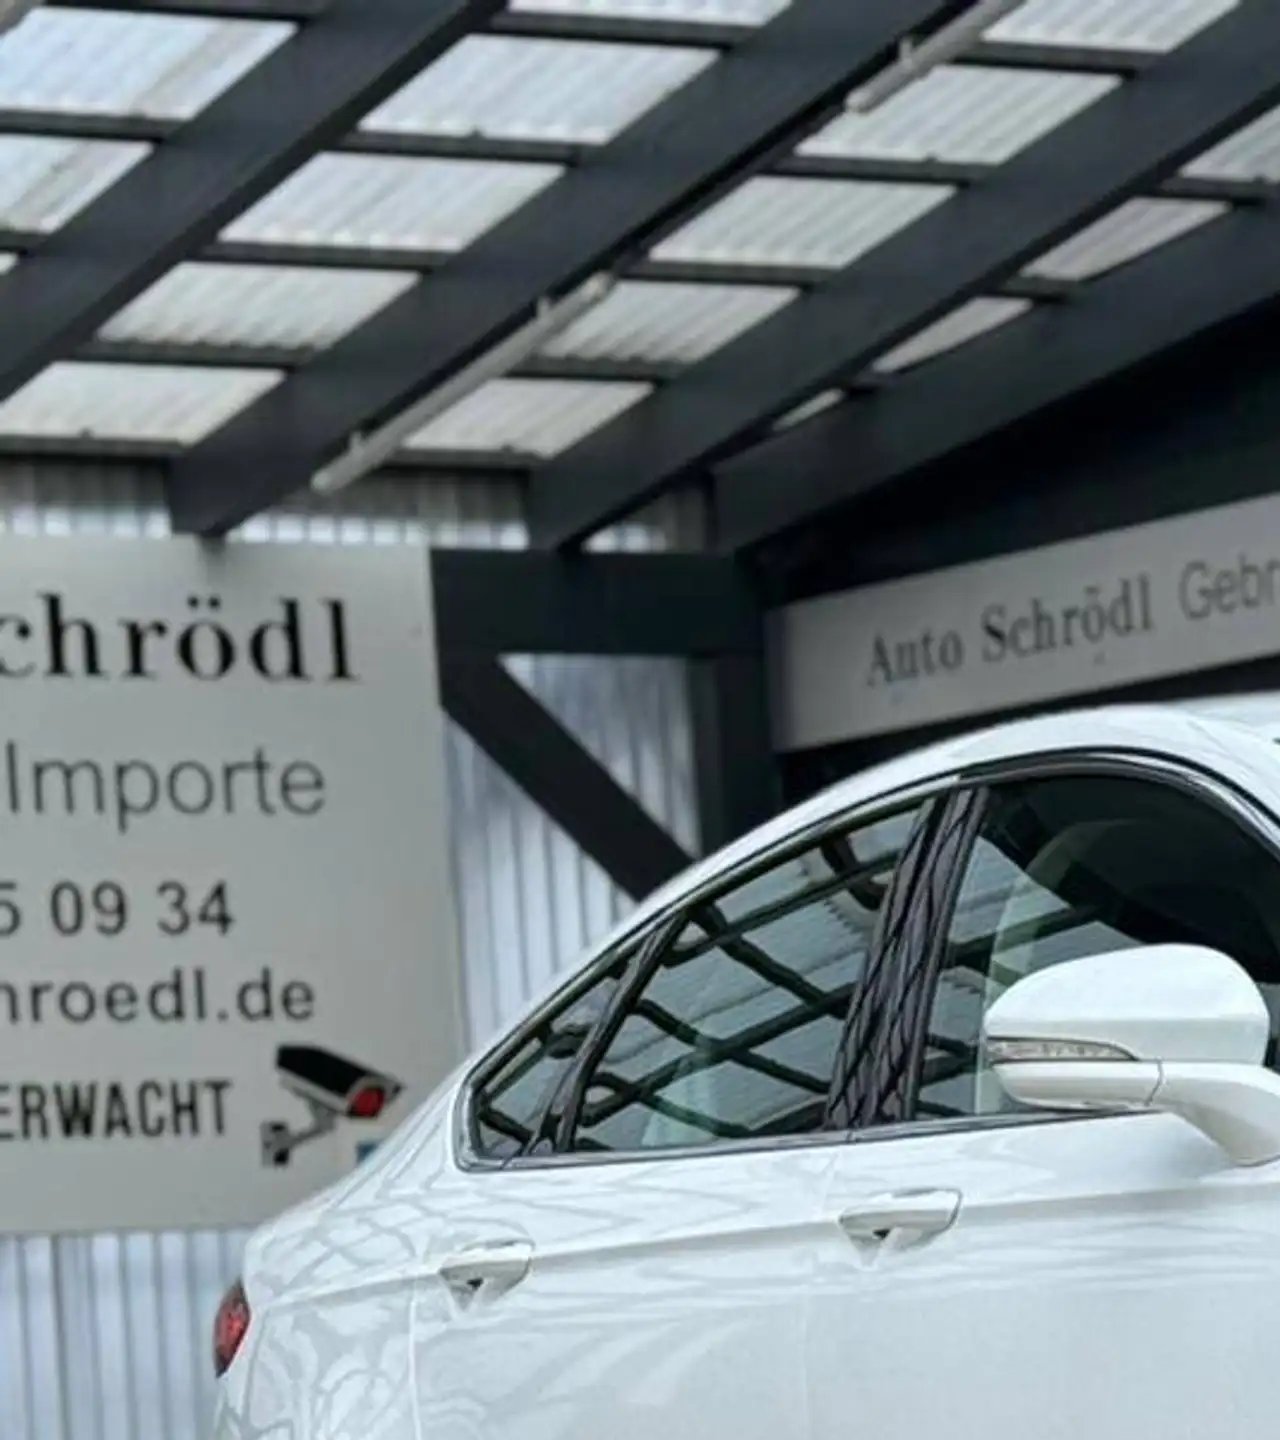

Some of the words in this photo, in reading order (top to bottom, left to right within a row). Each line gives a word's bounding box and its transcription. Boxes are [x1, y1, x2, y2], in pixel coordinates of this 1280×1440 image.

[866, 628, 963, 689] Auto
[981, 573, 1153, 662] Schrödl
[6, 738, 326, 835] Importe
[50, 879, 128, 938] 09
[156, 879, 235, 938] 34
